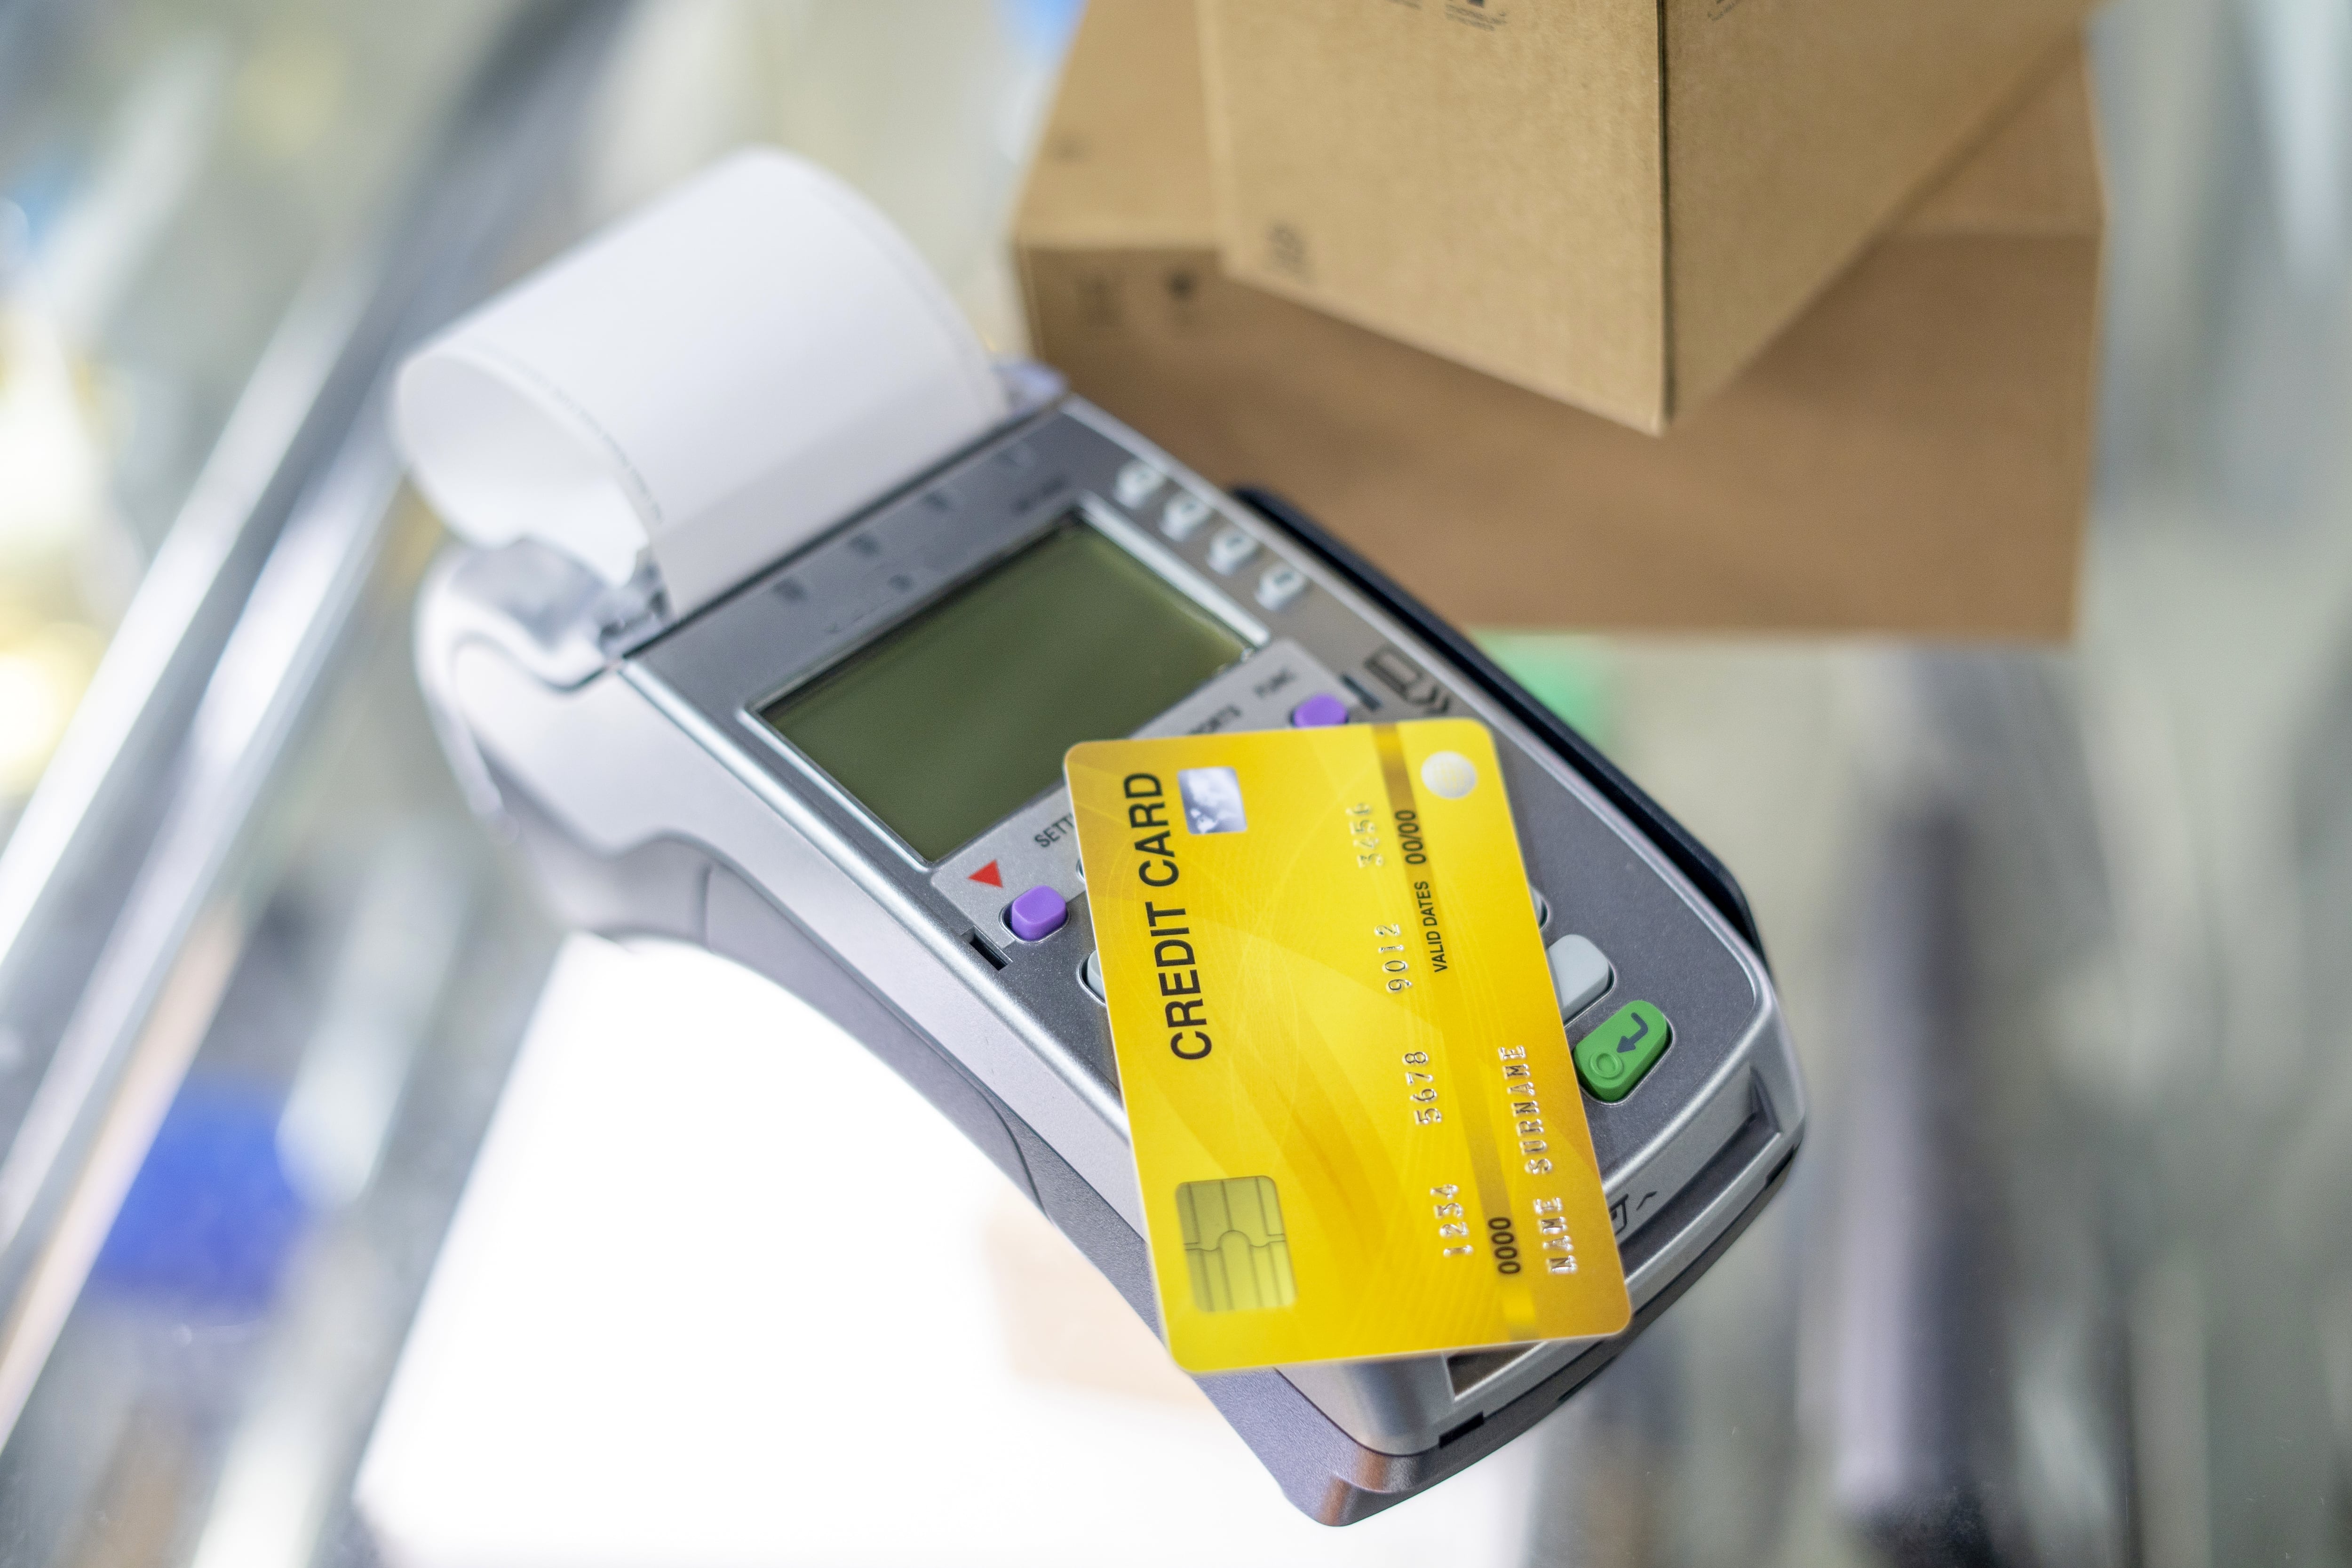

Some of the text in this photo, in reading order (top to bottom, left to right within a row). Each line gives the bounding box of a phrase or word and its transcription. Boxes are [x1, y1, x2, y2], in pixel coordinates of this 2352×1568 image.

[1123, 772, 1212, 1060] CREDIT CARD
[1394, 809, 1448, 972] VALID DATES 00/00
[1346, 803, 1473, 1258] 1234 5678 9012 3456
[1488, 1217, 1521, 1274] 0000
[1498, 1045, 1578, 1274] NAME SURNAME
